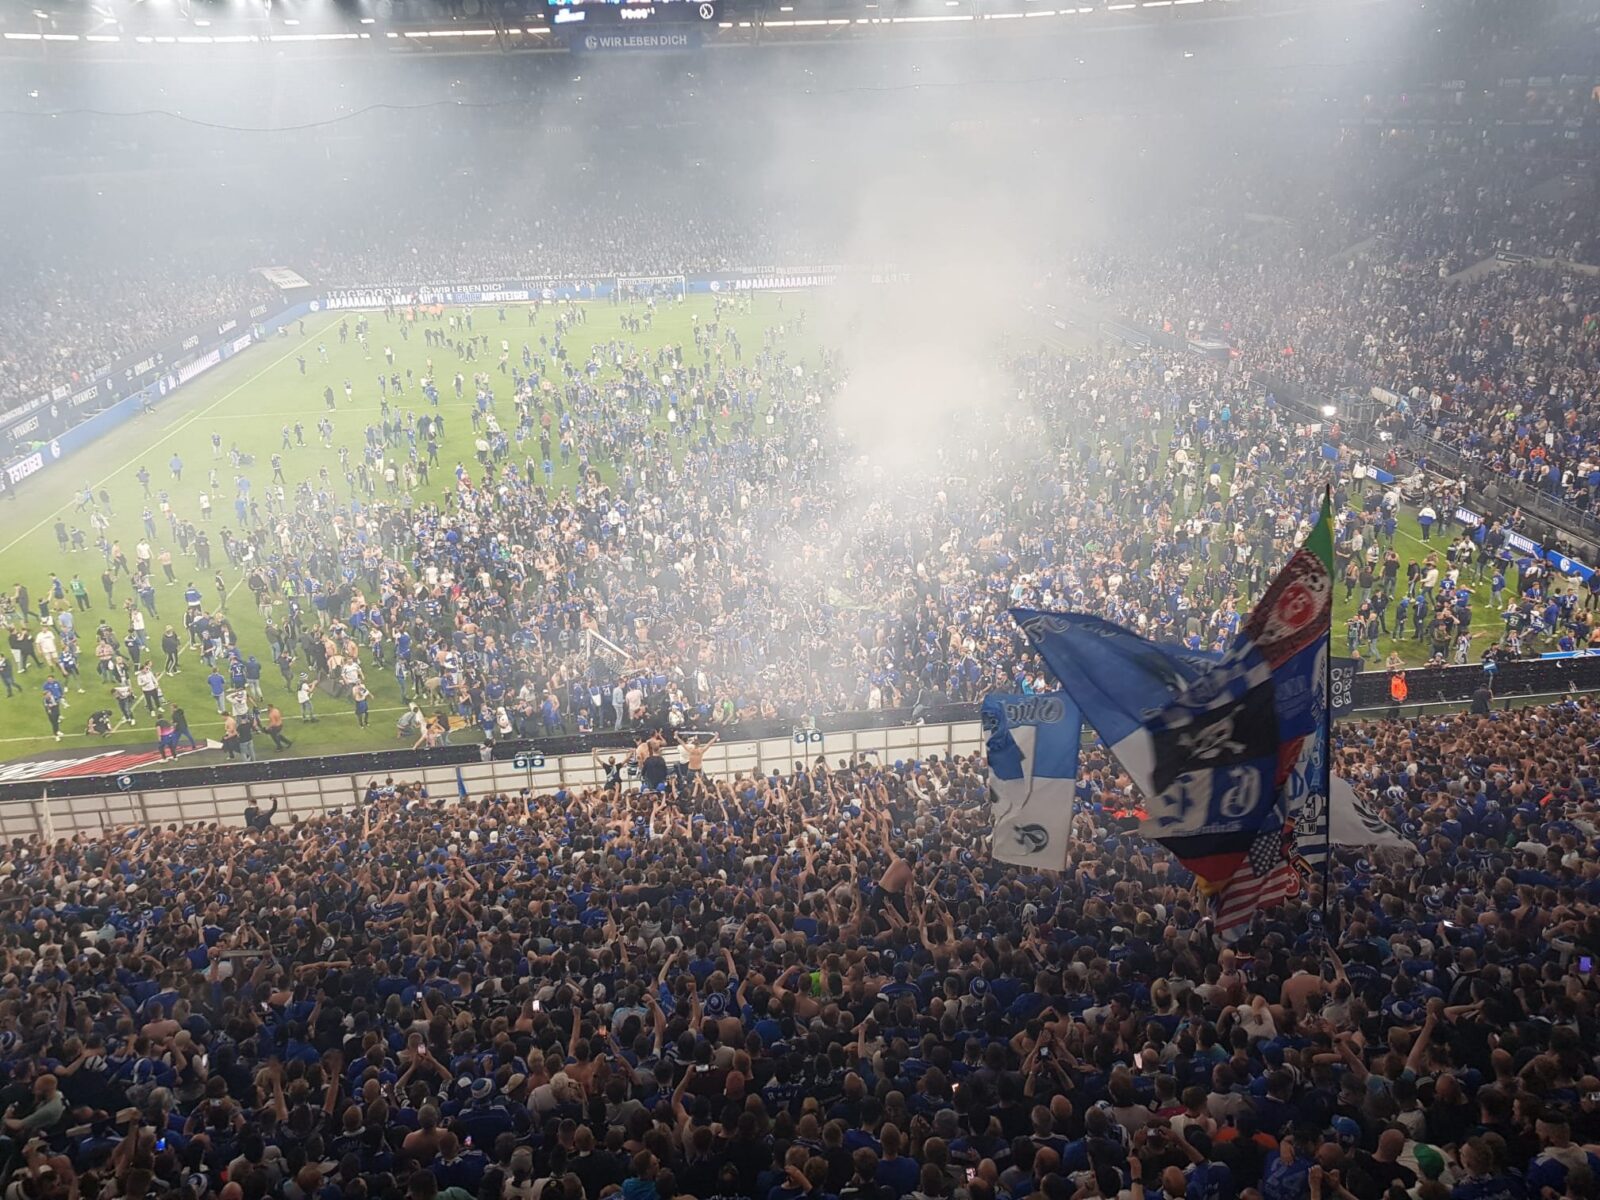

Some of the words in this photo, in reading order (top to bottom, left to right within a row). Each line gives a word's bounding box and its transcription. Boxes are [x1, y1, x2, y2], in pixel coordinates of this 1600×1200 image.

[599, 36, 622, 47] WIR
[624, 35, 659, 46] LEBEN
[660, 34, 688, 45] DICH
